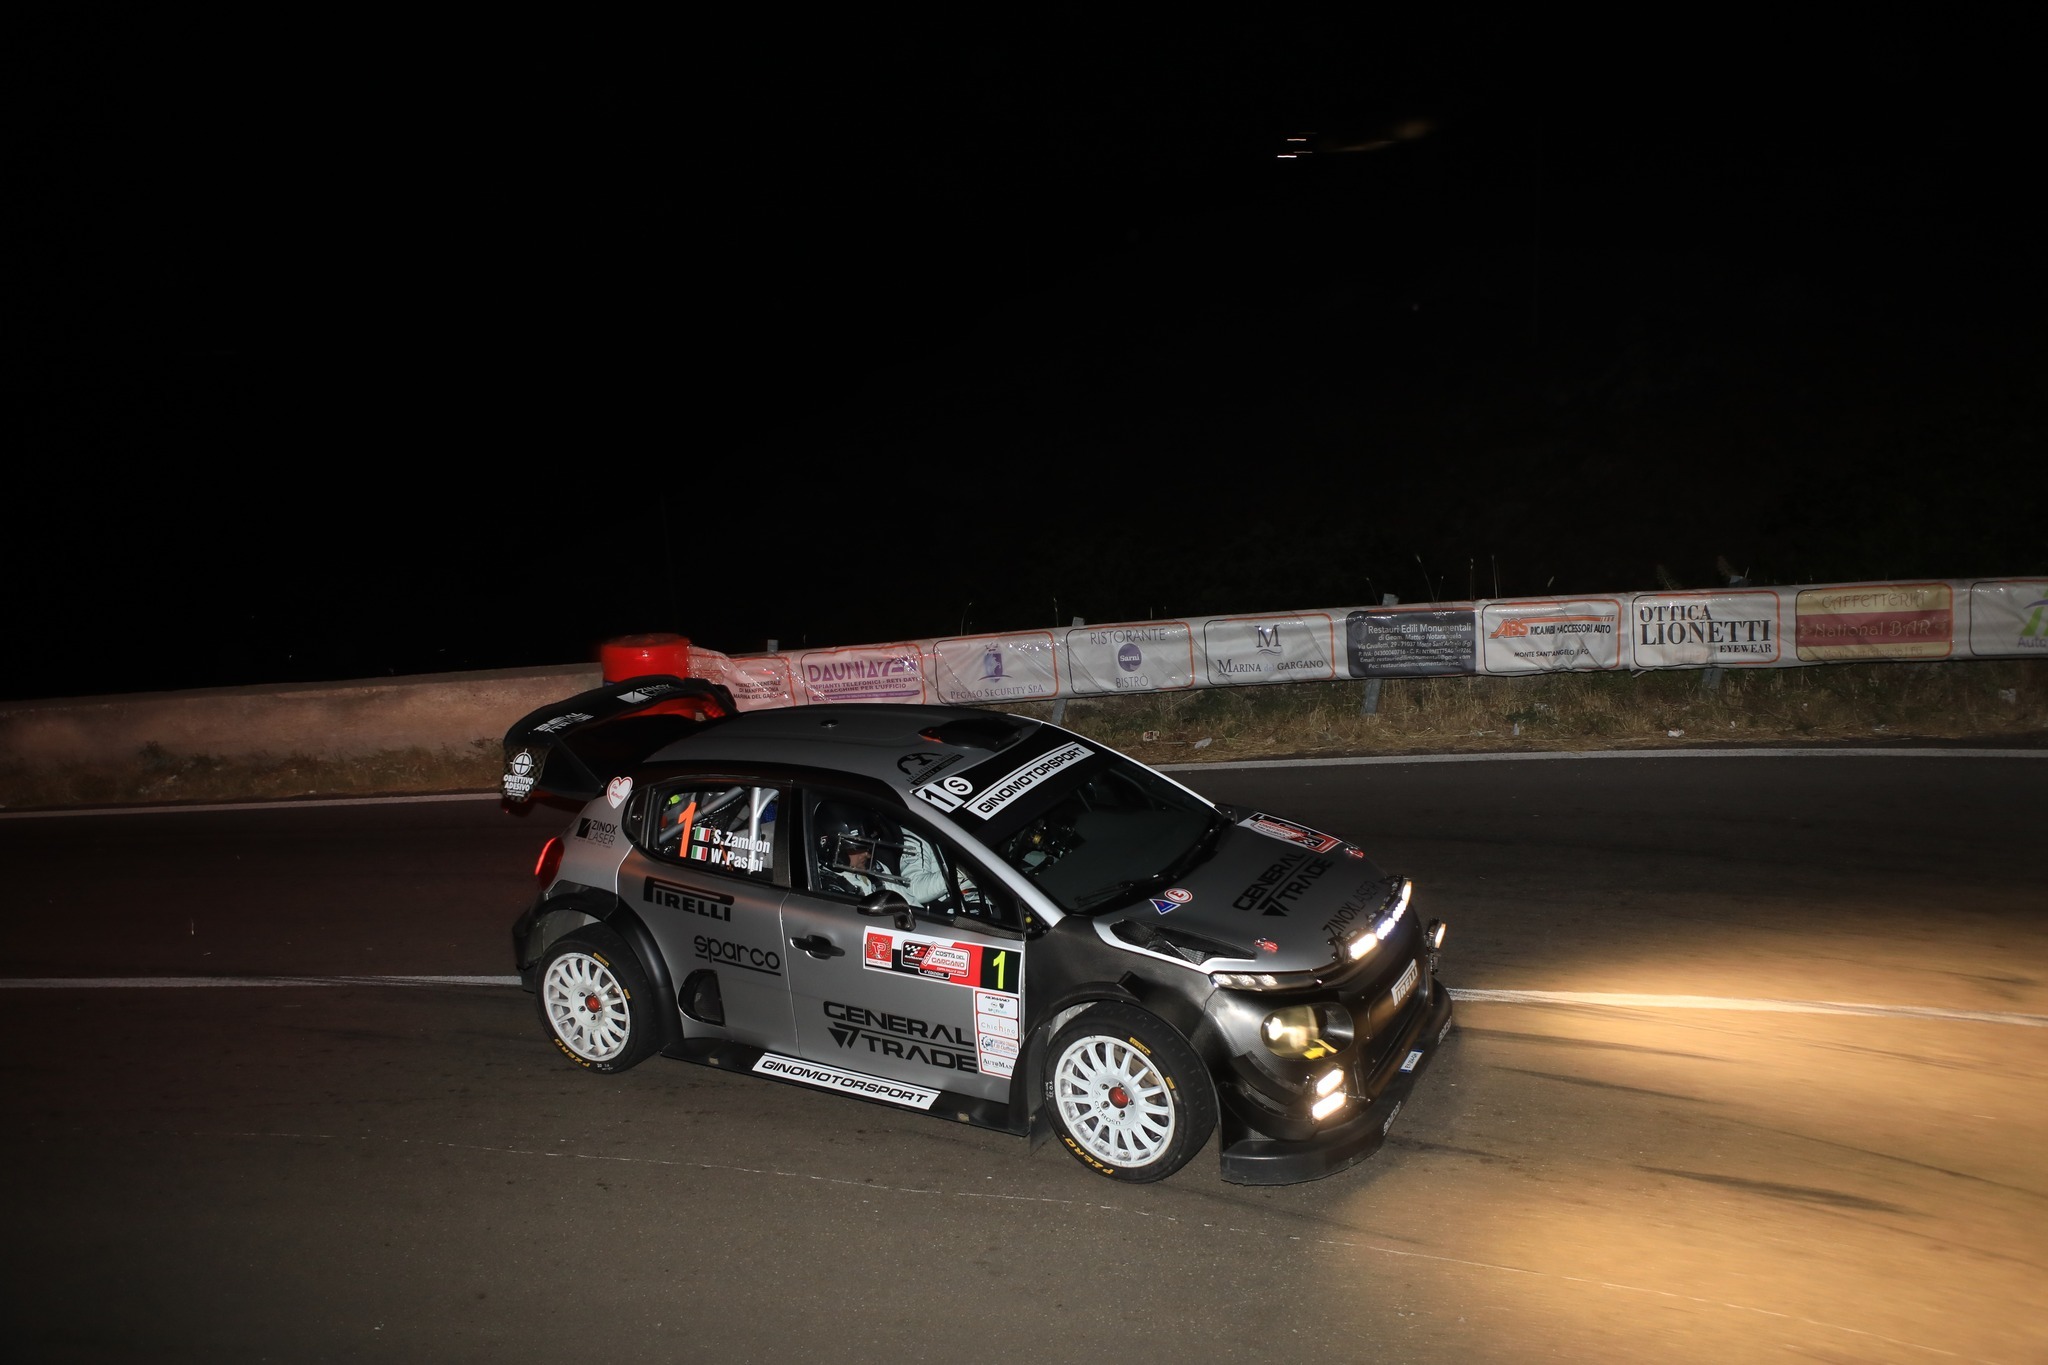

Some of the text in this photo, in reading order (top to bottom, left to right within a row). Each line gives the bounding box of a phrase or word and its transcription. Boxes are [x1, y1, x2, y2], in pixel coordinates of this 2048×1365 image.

[1640, 604, 1713, 622] OTTICA
[1090, 628, 1166, 645] RISTORANTE
[1368, 624, 1399, 634] Restauri
[1401, 623, 1418, 634] Edili
[1530, 625, 1556, 636] RICAMBI
[1594, 624, 1611, 634] AUTO
[1640, 619, 1771, 645] LIONETTI
[1719, 643, 1772, 653] EYEWEAR
[1120, 653, 1140, 662] Sarni
[1217, 658, 1262, 673] MARINA
[1277, 660, 1324, 671] GARGANO
[950, 690, 983, 700] PEGASO
[984, 685, 1026, 698] SECURITY
[503, 774, 534, 786] OBIETTIVO
[504, 781, 530, 792] ADESIVO
[977, 747, 1086, 814] GINOMOTORSPORT
[591, 819, 618, 836] ZINOX
[678, 801, 697, 858] 1
[643, 876, 735, 922] PIRELLI
[694, 935, 780, 970] sparco
[935, 950, 955, 959] COSTA
[931, 957, 965, 968] GARGANO
[993, 950, 1006, 989] 1
[823, 1000, 975, 1047] GENERAL
[861, 1033, 978, 1074] TRADE
[761, 1060, 929, 1103] GINOMOTORSPORT
